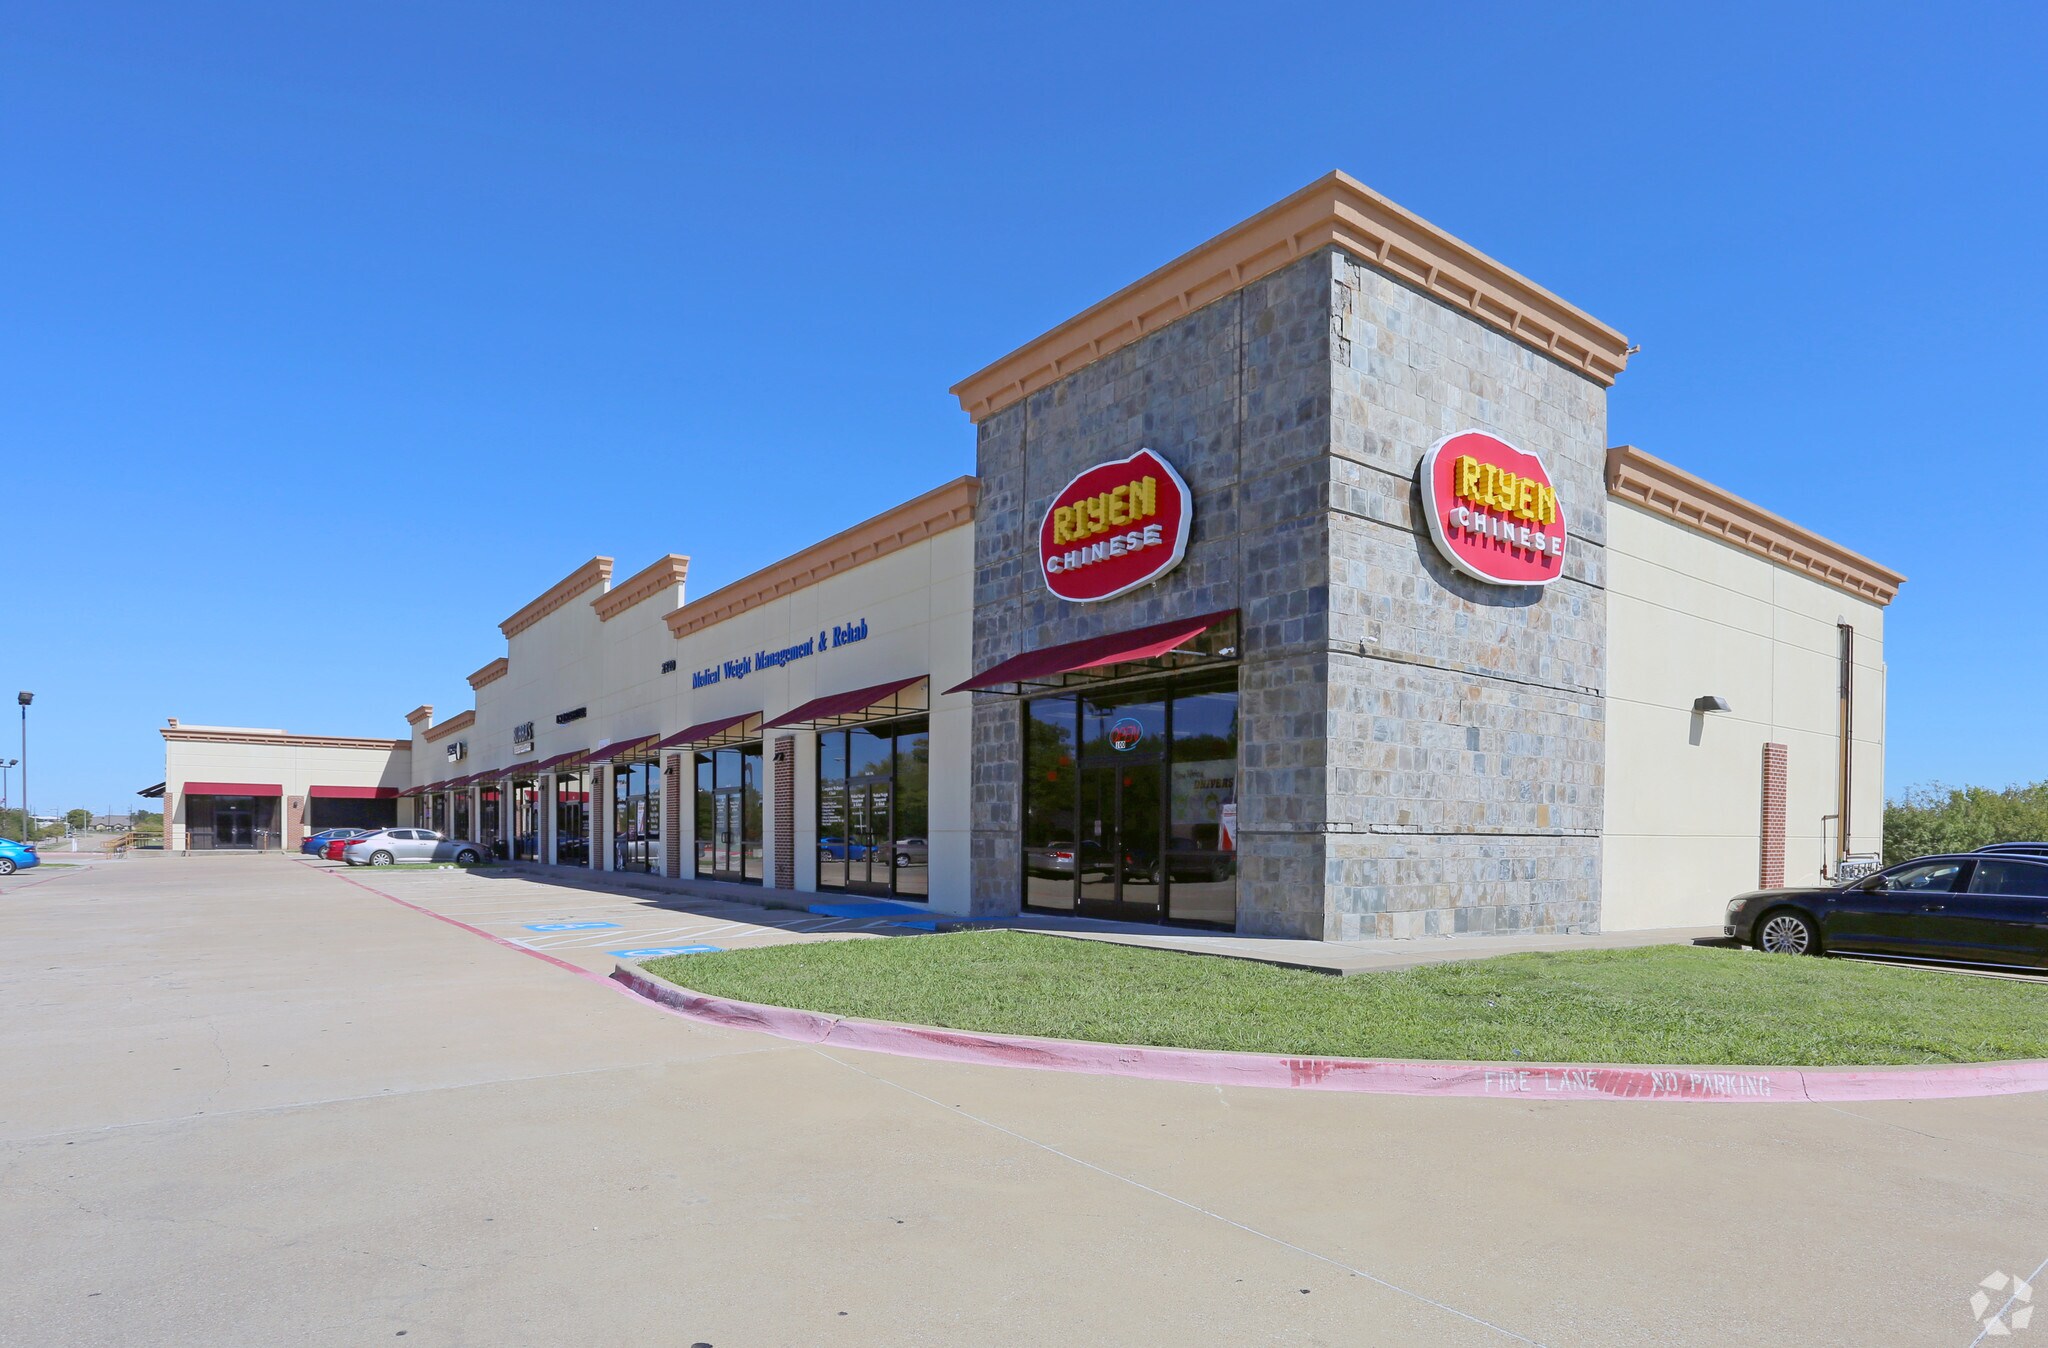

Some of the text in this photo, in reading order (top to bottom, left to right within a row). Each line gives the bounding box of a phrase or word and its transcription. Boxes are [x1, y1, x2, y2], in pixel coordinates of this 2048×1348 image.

[1053, 475, 1156, 545] RIYEN
[1455, 455, 1557, 525] RIYEN
[1046, 523, 1163, 574] CHINESE
[1450, 506, 1562, 556] CHINESE
[692, 618, 868, 690] Medical Weight Management & Rehab
[1112, 725, 1140, 743] OPEN
[1116, 741, 1125, 749] 100
[1194, 777, 1233, 790] DRIVERS
[1484, 1071, 1772, 1096] FIRE LANE NO PARKING
